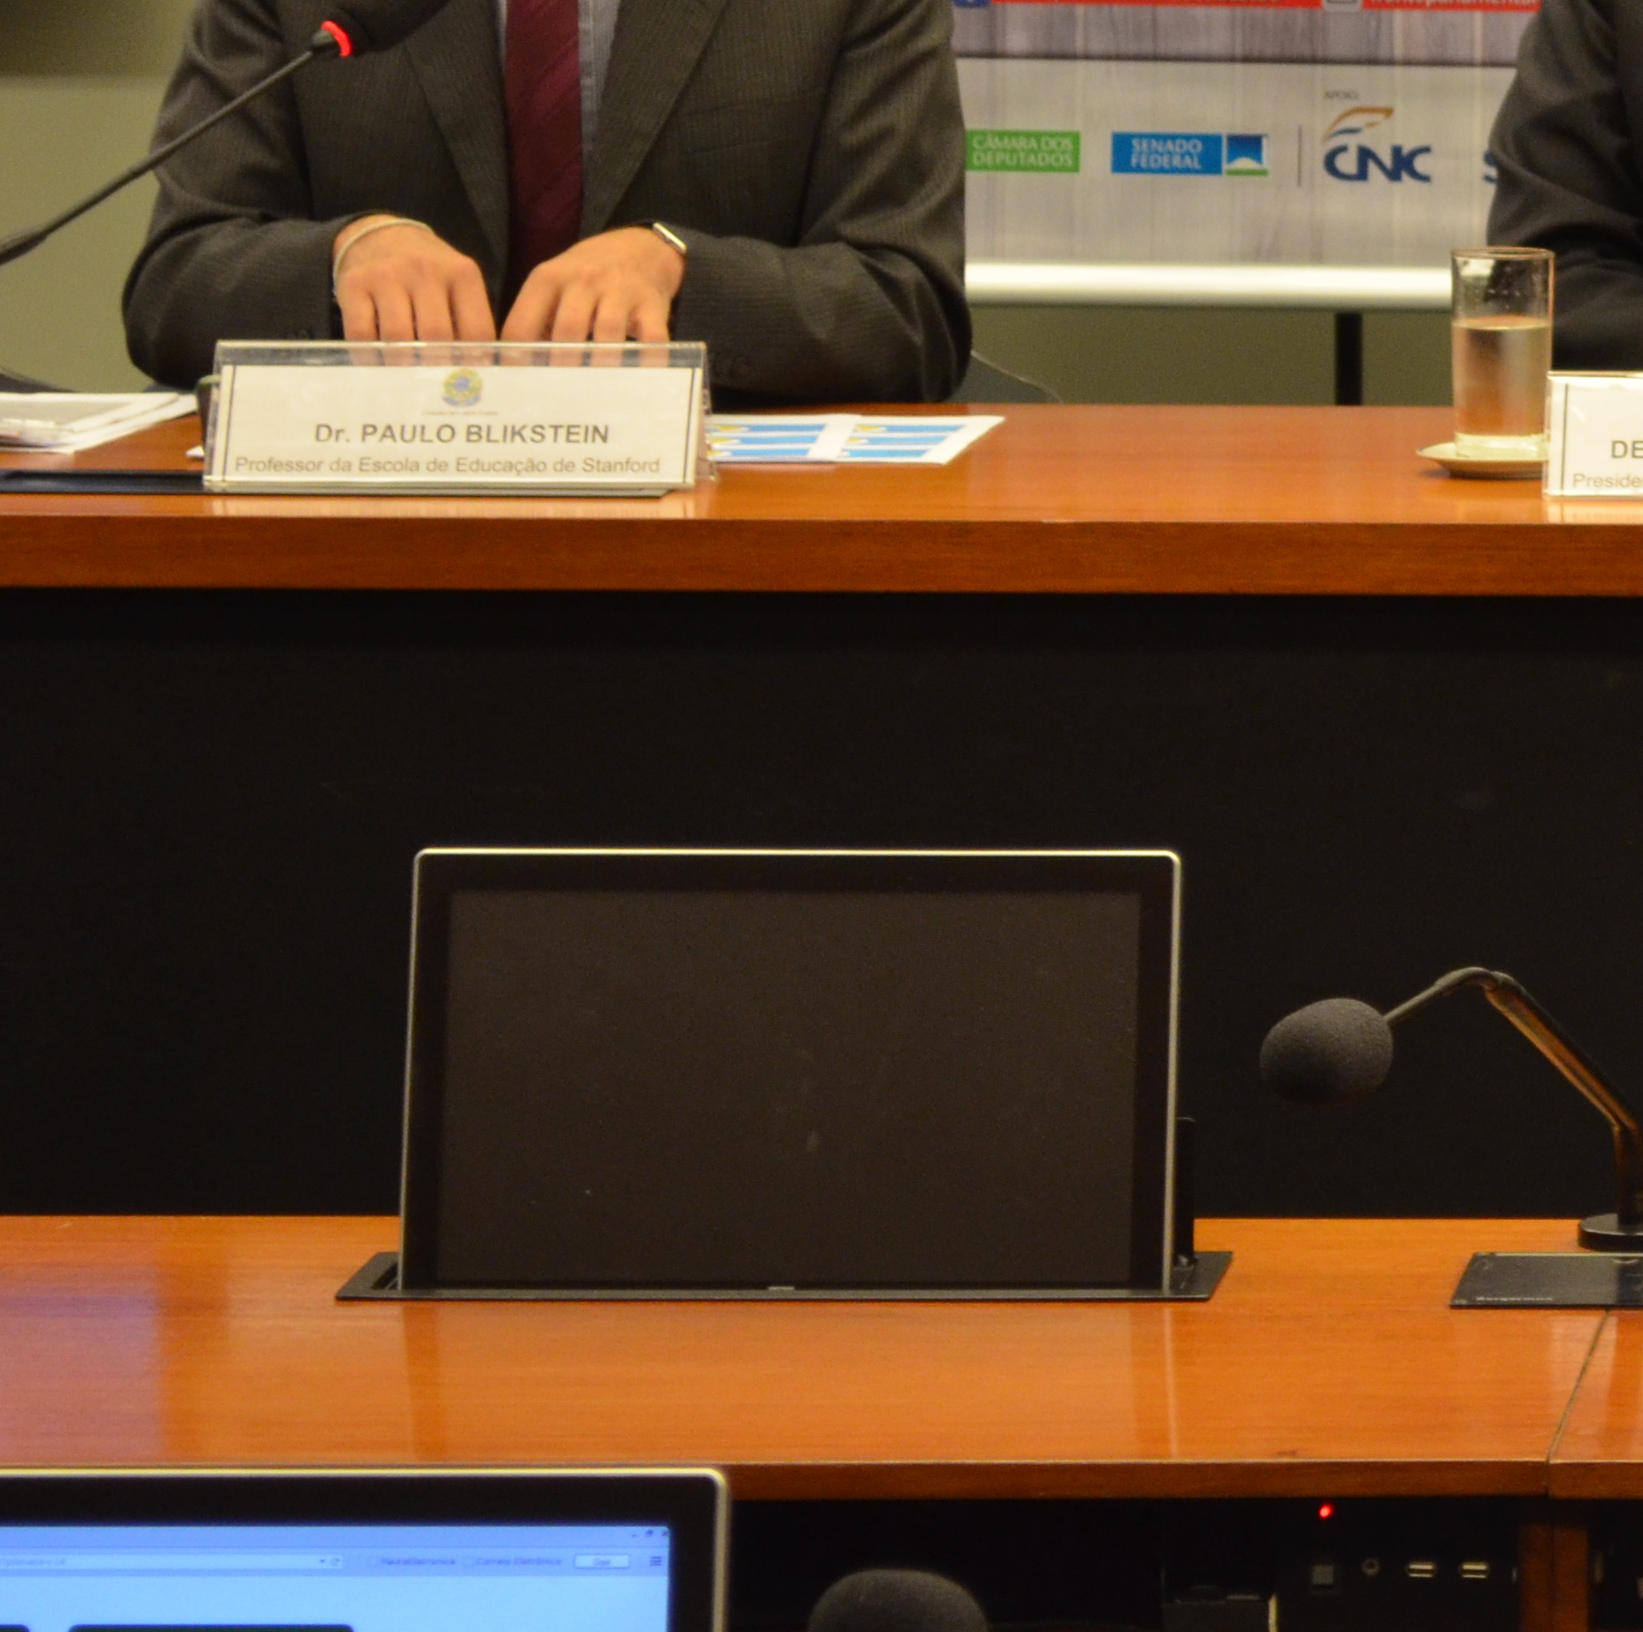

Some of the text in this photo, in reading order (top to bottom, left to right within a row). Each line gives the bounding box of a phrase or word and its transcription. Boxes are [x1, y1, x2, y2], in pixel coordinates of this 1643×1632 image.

[972, 135, 1074, 152] CÂMARA DOS
[1131, 138, 1202, 153] SENADO
[972, 151, 1074, 167] DEPUTADOS
[1130, 153, 1202, 169] FEDERAL
[1323, 144, 1433, 183] CNC
[314, 423, 609, 444] Dr. PAULO BLIKSTEIN
[235, 456, 661, 476] Professor da Escola de Educação de Stanford
